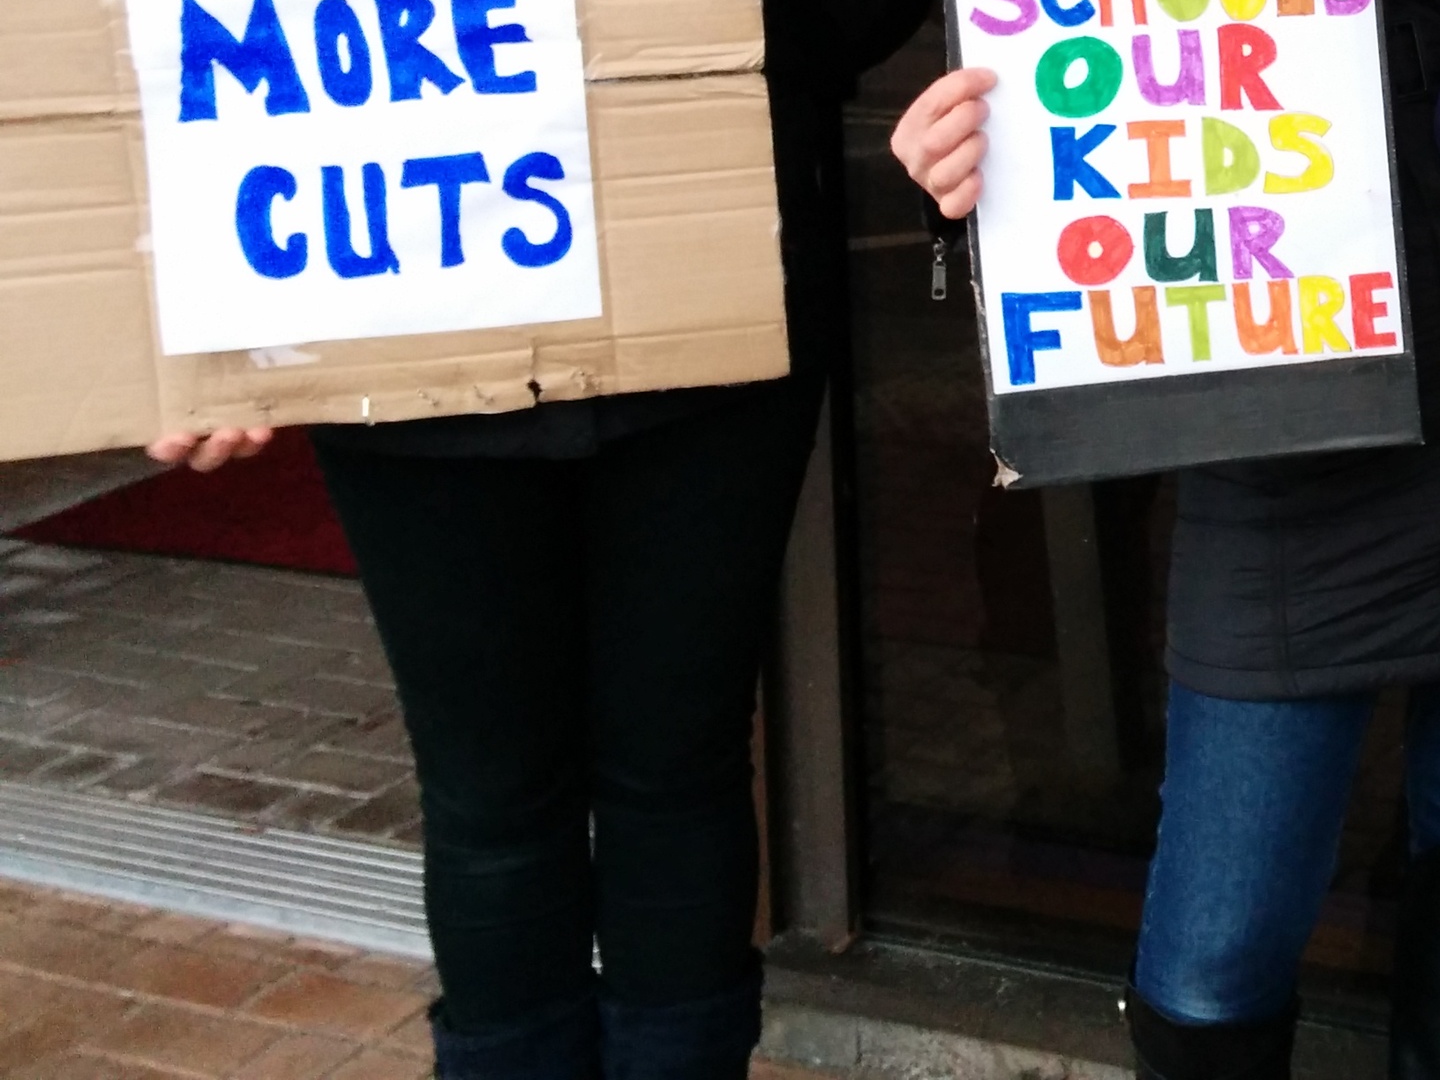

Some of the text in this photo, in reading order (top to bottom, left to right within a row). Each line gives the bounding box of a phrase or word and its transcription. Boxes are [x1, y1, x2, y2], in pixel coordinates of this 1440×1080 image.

[1035, 24, 1284, 118] OUR
[1050, 111, 1334, 200] KIDS
[235, 151, 572, 279] CUTS
[1057, 206, 1294, 285] OUR
[1001, 272, 1396, 385] FUTURE
